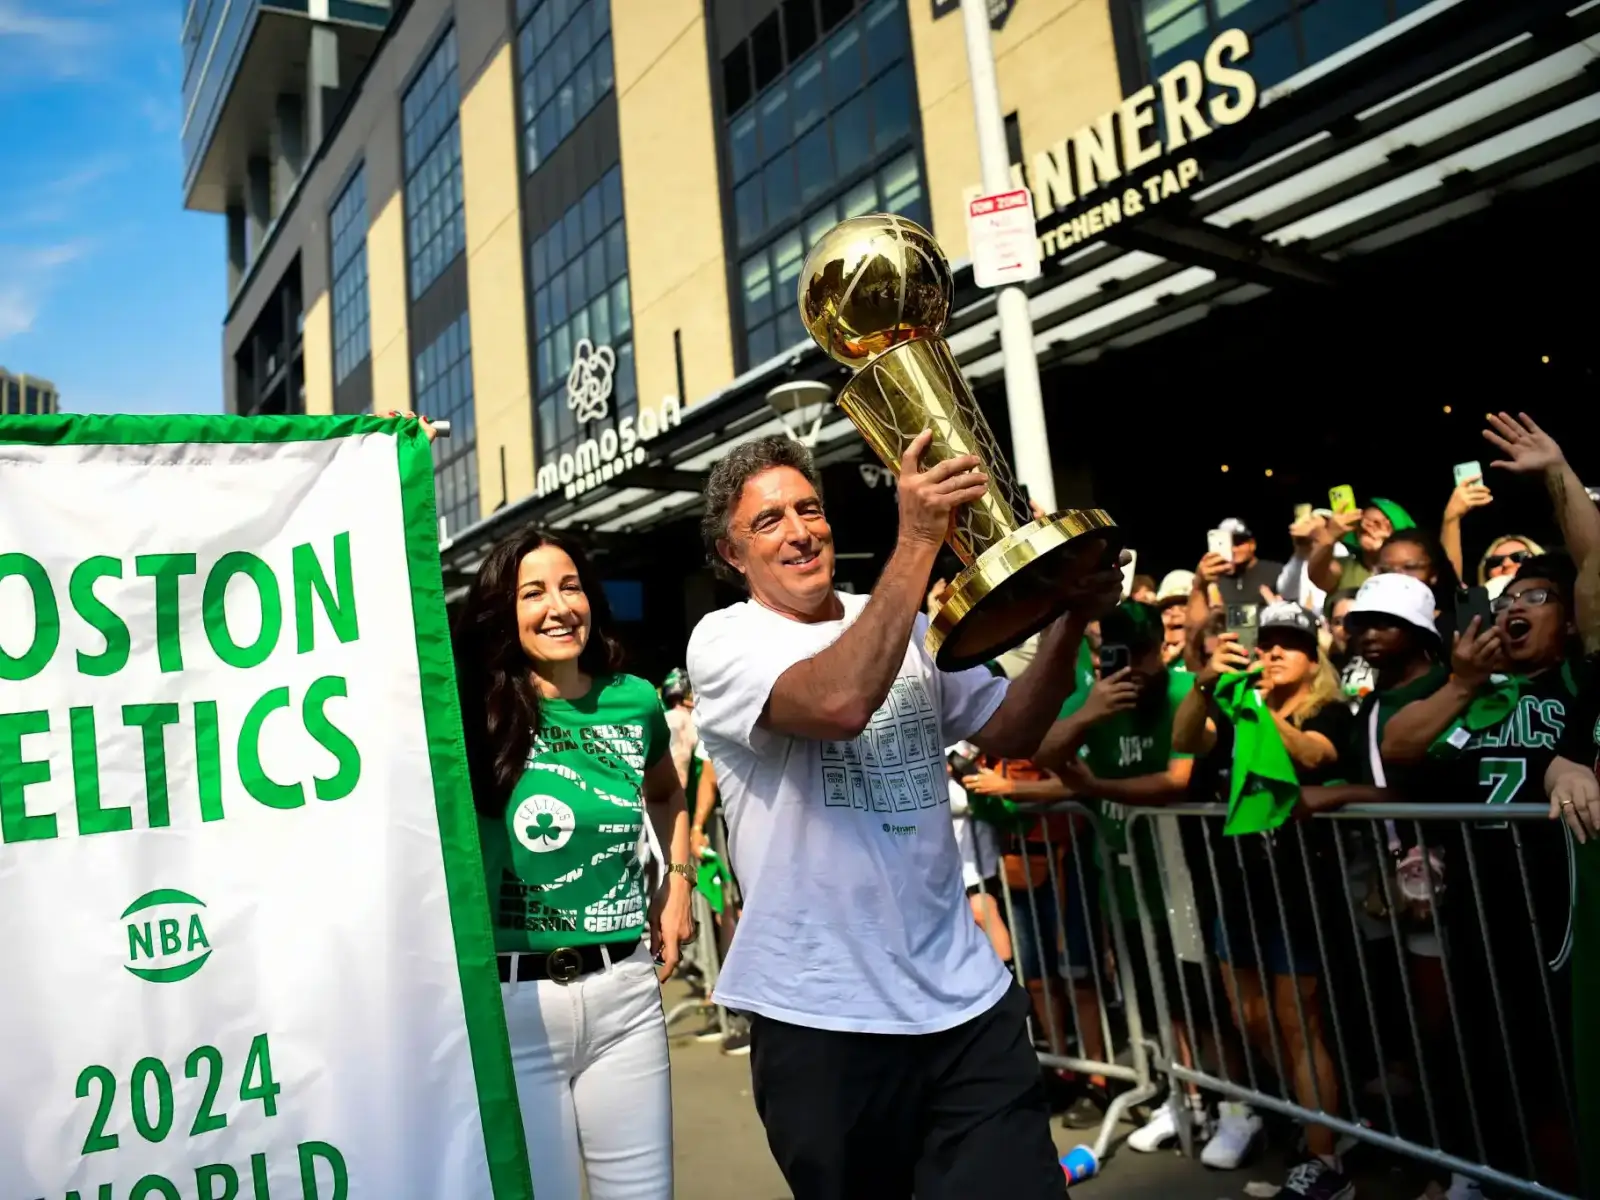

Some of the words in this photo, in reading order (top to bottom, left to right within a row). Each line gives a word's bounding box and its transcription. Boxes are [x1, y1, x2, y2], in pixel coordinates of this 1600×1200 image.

[1010, 28, 1257, 221] NNERS
[1037, 197, 1122, 262] ITCHEN
[1122, 188, 1145, 217] &
[1142, 157, 1199, 204] TAP
[519, 799, 571, 821] CELTICS
[1478, 757, 1527, 829] 7
[127, 913, 210, 960] NBA
[584, 911, 645, 932] CELTICS
[75, 1033, 281, 1155] 2024
[34, 1141, 348, 1200] RLD
